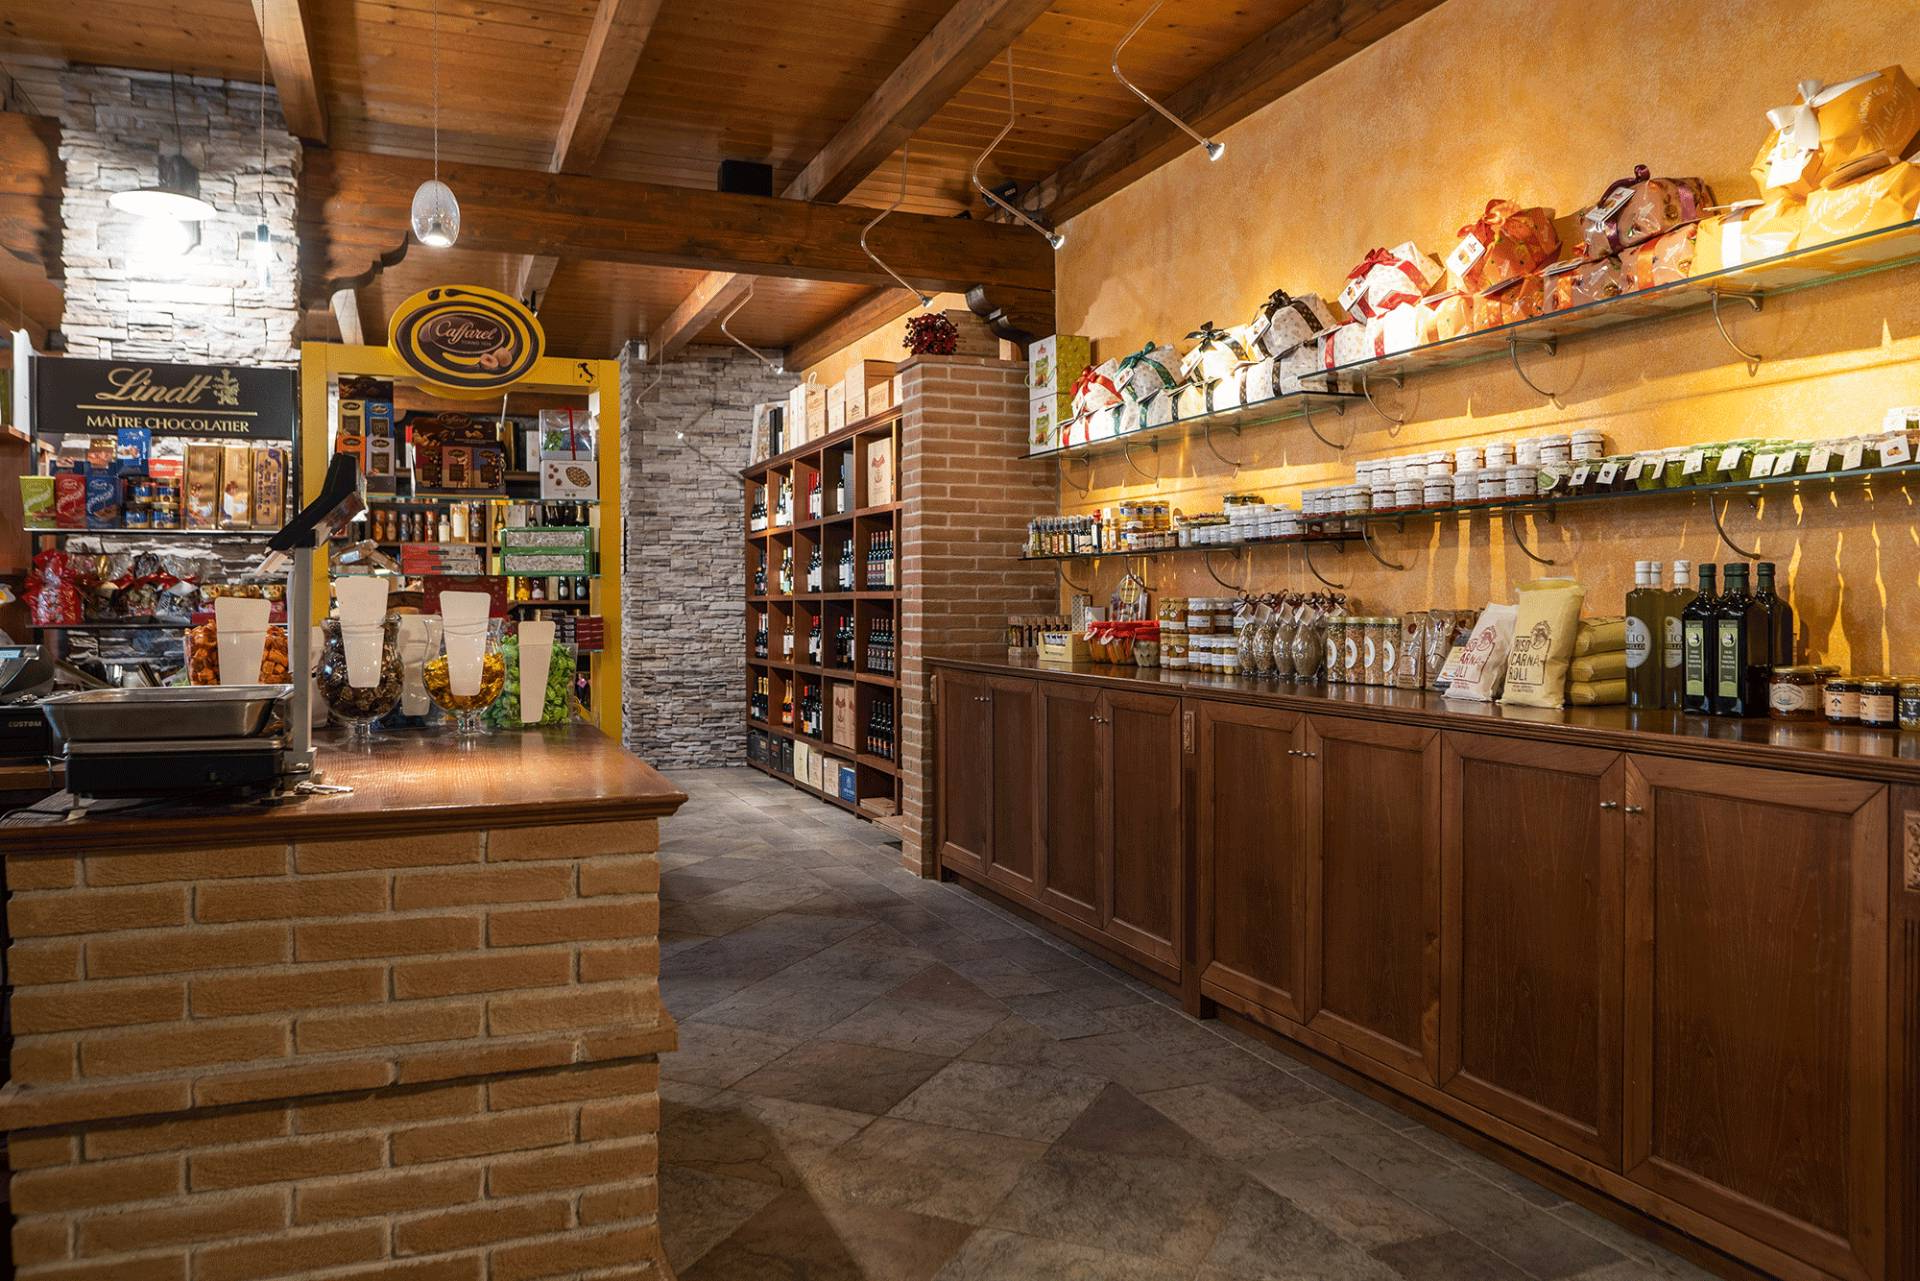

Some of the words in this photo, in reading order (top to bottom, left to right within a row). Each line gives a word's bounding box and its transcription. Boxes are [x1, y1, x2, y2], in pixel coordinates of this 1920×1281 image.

[436, 320, 498, 344] Caffarel
[95, 368, 212, 404] Lindt
[86, 413, 142, 428] MAÎTRE
[144, 417, 249, 433] CHOCOLATIER
[1513, 639, 1531, 652] RISO
[1508, 667, 1528, 681] ROLI
[8, 720, 42, 728] CUSTOM
